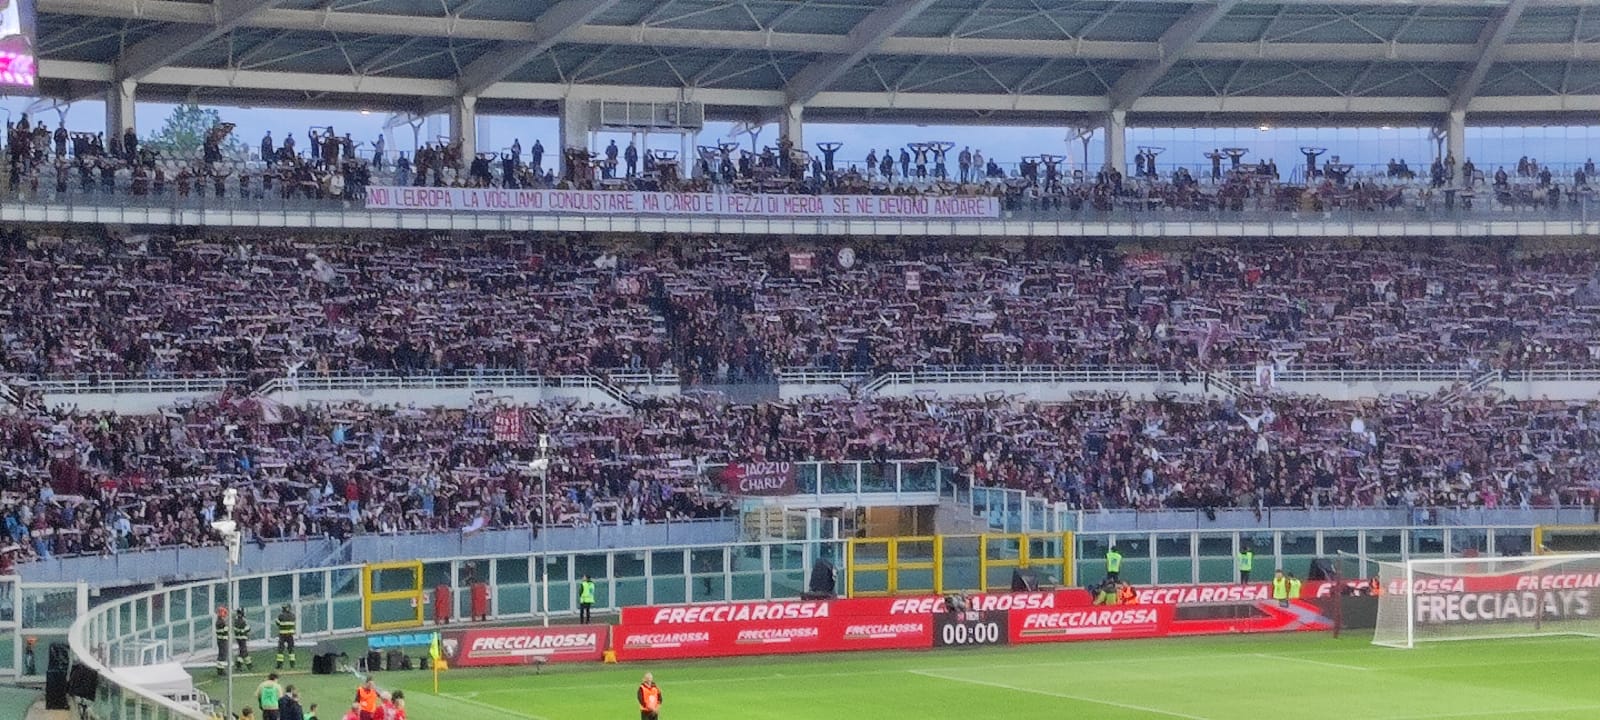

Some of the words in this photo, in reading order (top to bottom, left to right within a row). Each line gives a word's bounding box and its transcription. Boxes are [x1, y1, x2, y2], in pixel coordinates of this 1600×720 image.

[370, 188, 390, 206] NOI
[462, 190, 479, 208] LA
[483, 190, 543, 209] VOGLIAMO
[642, 193, 660, 210] MA
[664, 194, 700, 212] CAIRO
[705, 195, 713, 212] E
[727, 196, 764, 213] PEZZI
[767, 196, 779, 213] DI
[783, 197, 824, 214] MERDA
[833, 197, 851, 214] SE
[856, 197, 873, 214] NE
[879, 197, 929, 214] DEVONO
[934, 198, 985, 215] ANDARE
[740, 476, 786, 491] CHARLY
[654, 602, 830, 625] FRECCIAROSSA
[1416, 590, 1589, 622] FRECCIADAYS
[1023, 609, 1158, 628] FRECCIAROSSA
[737, 627, 819, 640] FRECCIAROSSA
[845, 623, 924, 636] FRECCIAROSSA
[942, 622, 999, 645] 00:00
[471, 633, 597, 651] FRECCIAROSSA
[625, 632, 710, 646] FRECCIAROSSA
